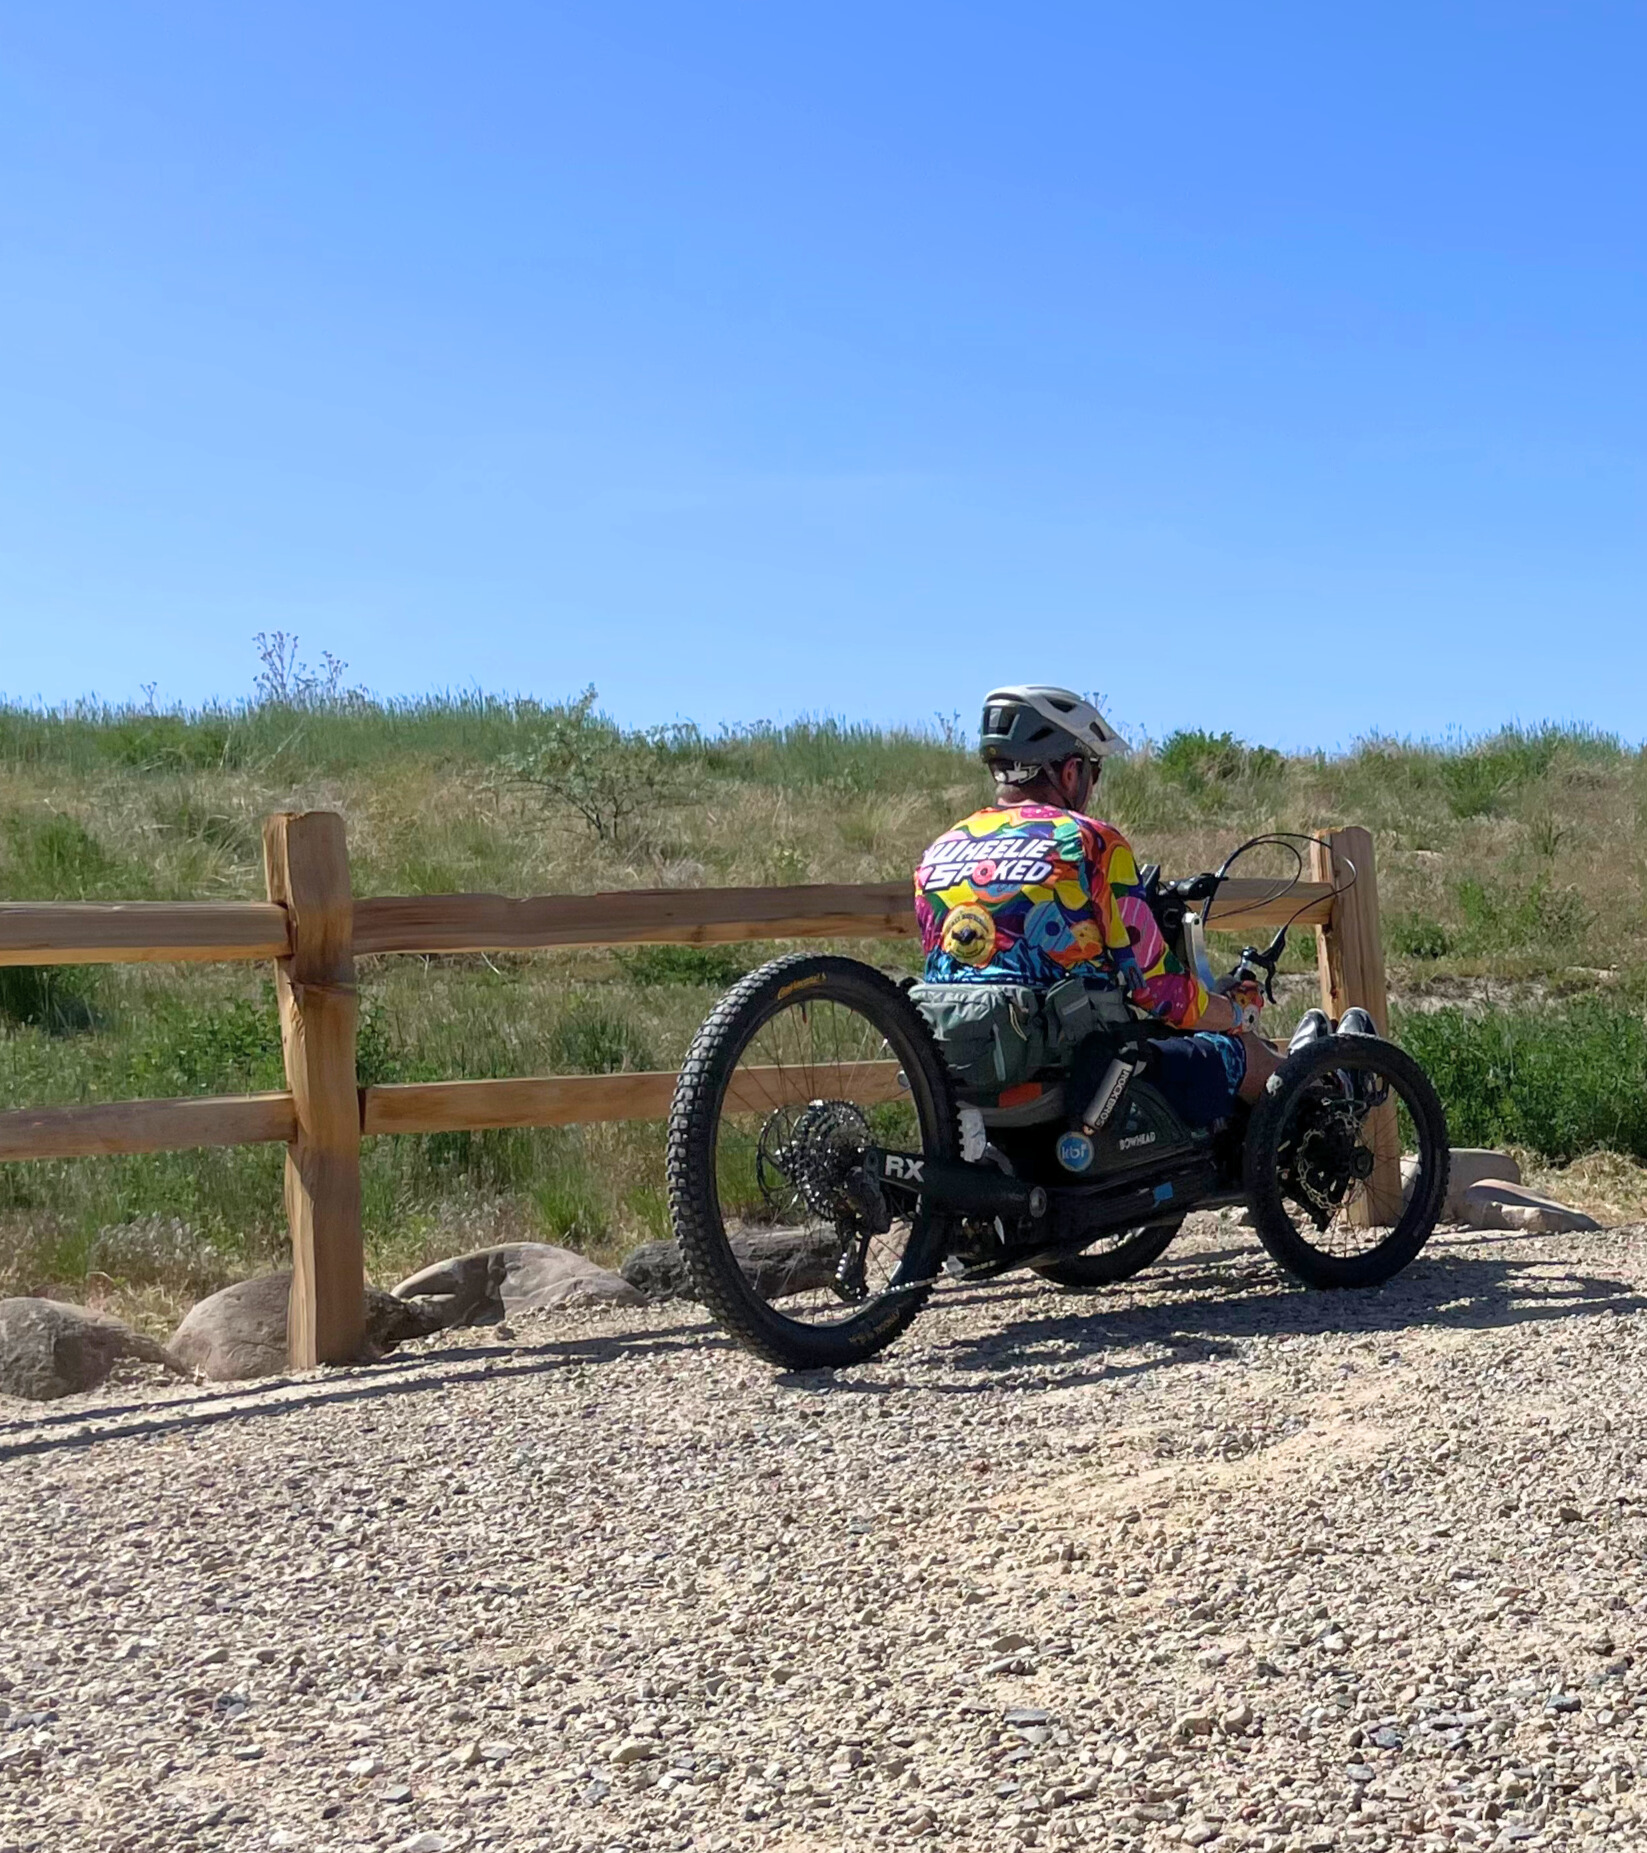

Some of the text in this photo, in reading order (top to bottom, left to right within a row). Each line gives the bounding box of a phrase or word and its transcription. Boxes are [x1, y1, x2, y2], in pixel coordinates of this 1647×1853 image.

[923, 838, 1057, 865] WHEELIE
[924, 859, 1053, 891] SPOKED
[1094, 1068, 1131, 1129] ROCKBROS
[1119, 1131, 1156, 1150] BOWHEAD
[884, 1154, 925, 1183] RX
